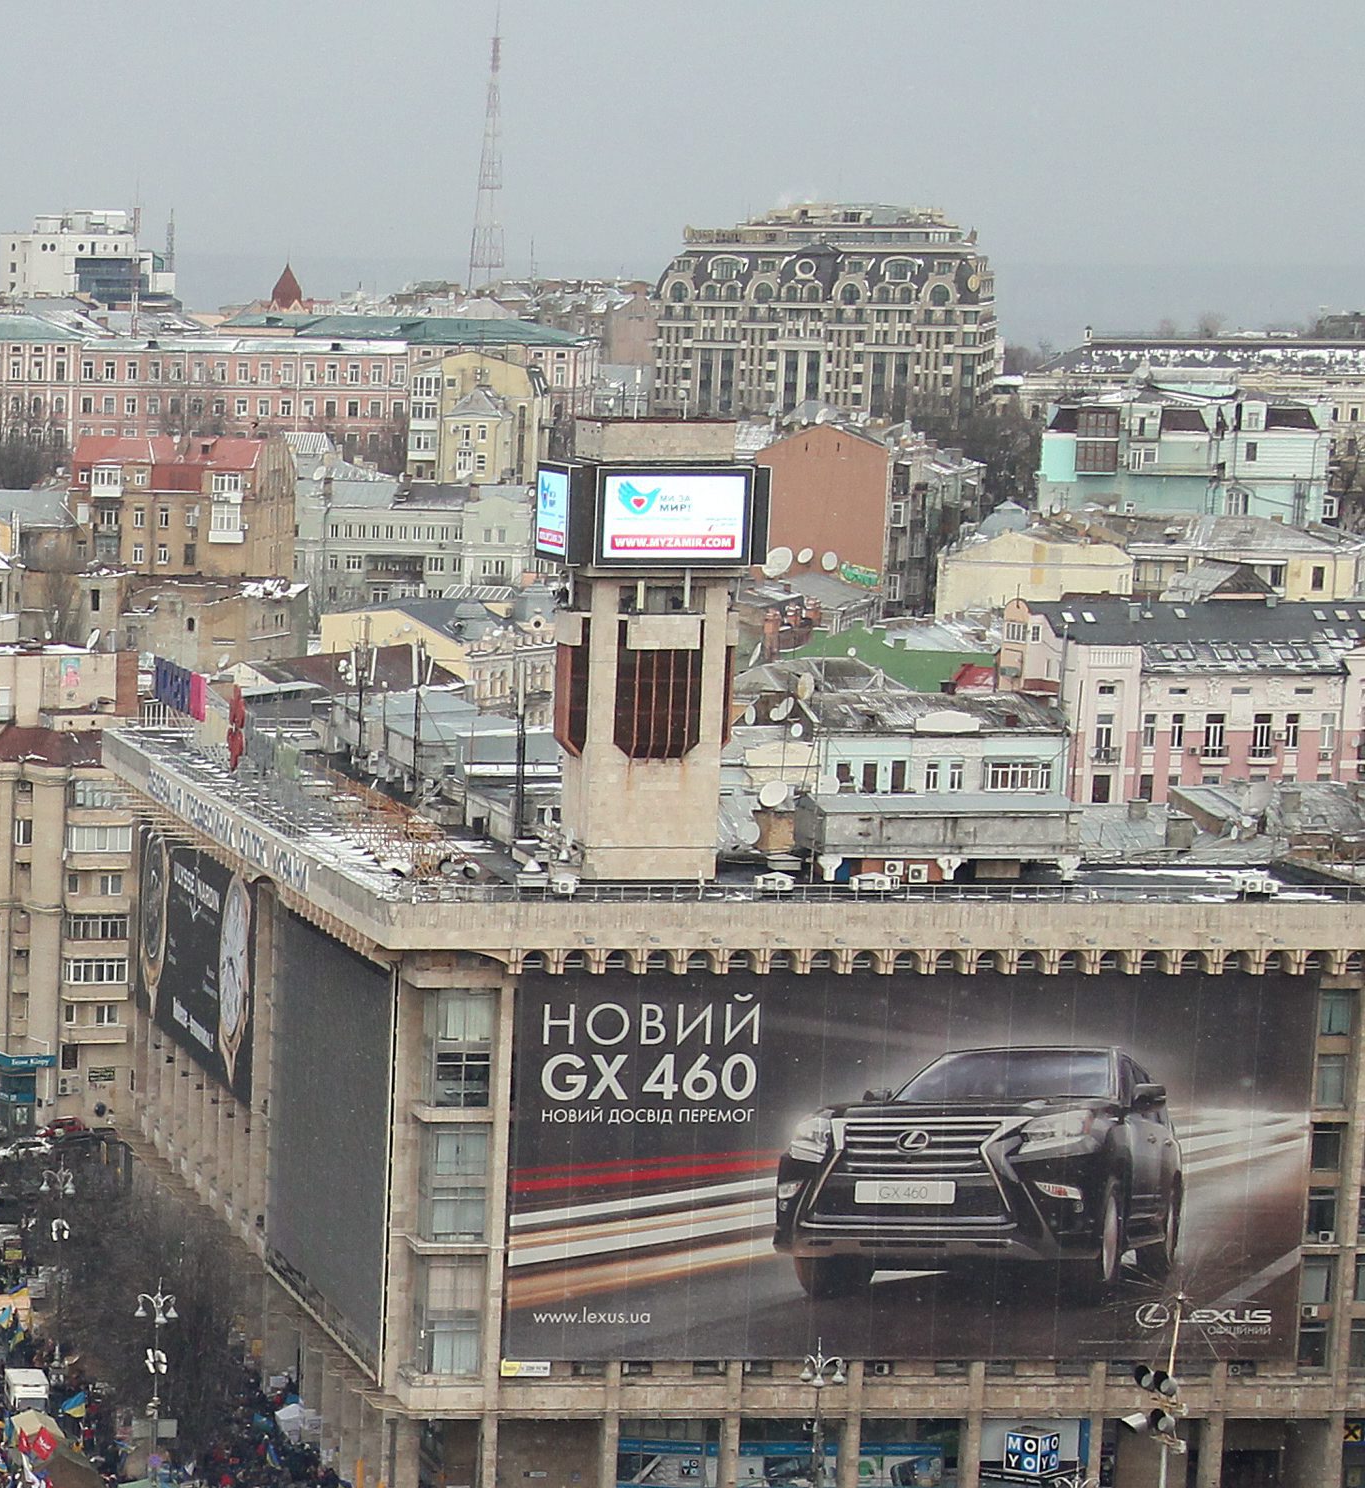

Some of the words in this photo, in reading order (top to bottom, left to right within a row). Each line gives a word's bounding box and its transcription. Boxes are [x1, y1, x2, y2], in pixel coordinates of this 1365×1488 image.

[615, 536, 732, 548] WWW.MYZAMIR.COM
[542, 993, 761, 1046] НОВИЙ
[541, 1053, 629, 1101] GX
[642, 1053, 757, 1101] 460
[542, 1106, 603, 1123] НОВИЙ
[608, 1109, 673, 1125] ДОСВІД
[678, 1108, 755, 1123] ПЕРЕМОГ
[879, 1186, 900, 1199] GX
[903, 1186, 928, 1199] 460
[533, 1307, 651, 1324] www.lexus.ua
[1175, 1309, 1273, 1324] LEXUS
